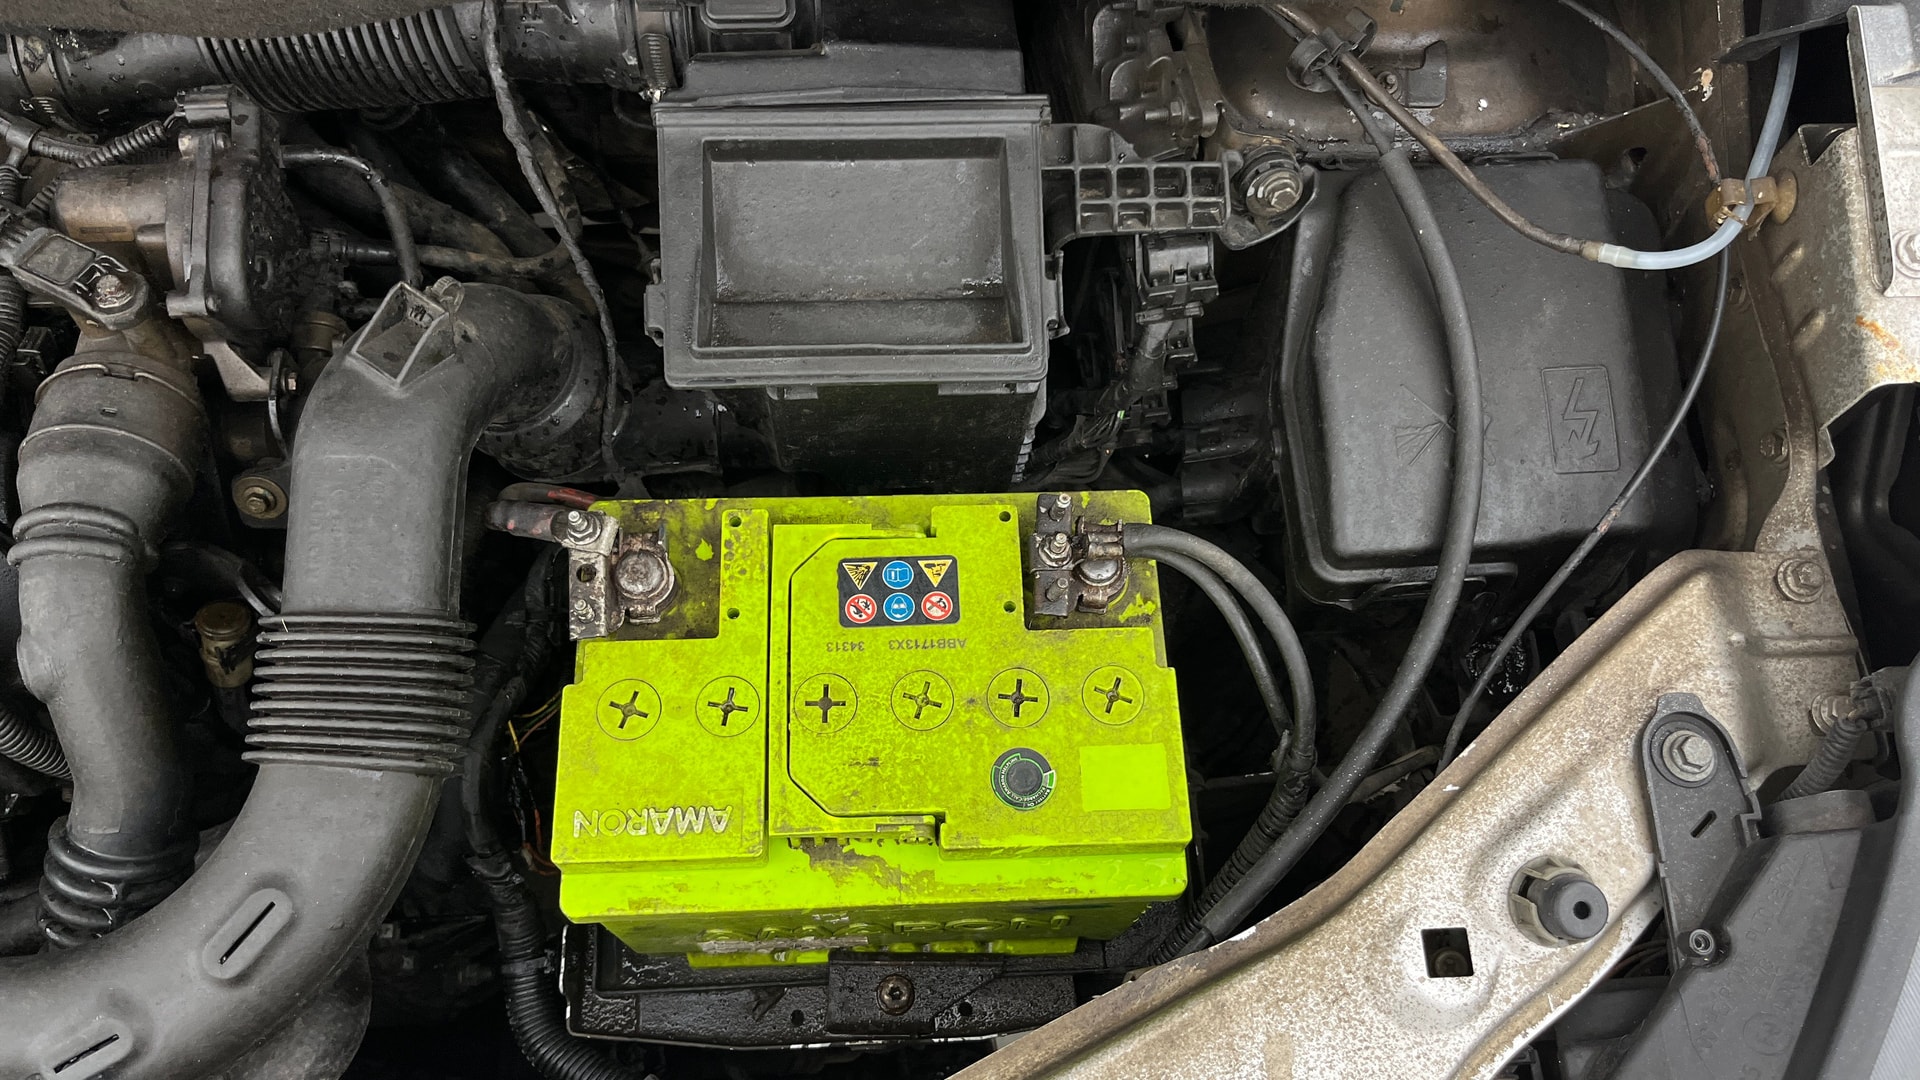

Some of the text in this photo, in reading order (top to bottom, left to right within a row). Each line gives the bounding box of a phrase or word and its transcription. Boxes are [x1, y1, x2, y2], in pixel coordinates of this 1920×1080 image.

[826, 637, 967, 652] ABB1713X3 34313
[573, 805, 733, 838] AMARON
